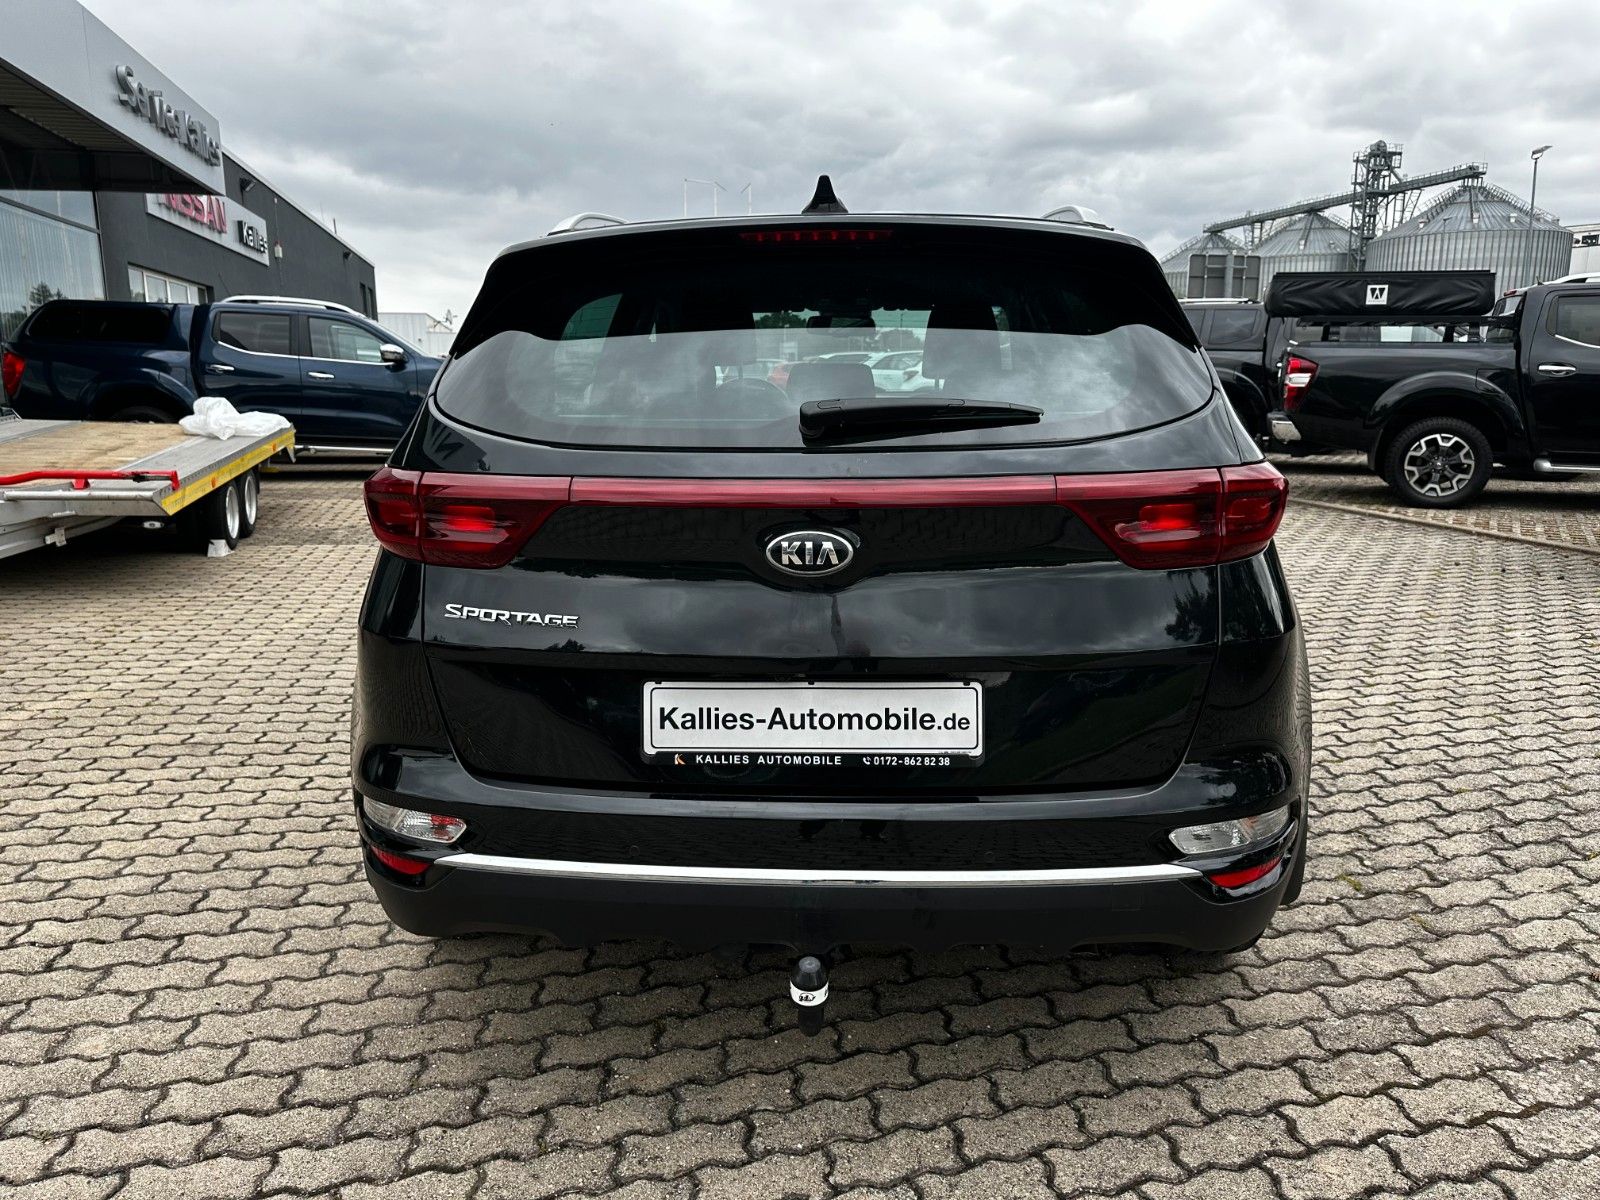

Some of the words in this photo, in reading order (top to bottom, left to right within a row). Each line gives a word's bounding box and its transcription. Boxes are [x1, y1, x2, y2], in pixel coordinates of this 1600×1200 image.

[780, 541, 839, 565] KIA
[444, 603, 579, 629] SPORTAGE
[659, 707, 971, 731] Kallies-Automobile.de
[695, 754, 750, 765] KALLIES
[757, 755, 842, 766] AUTOMOBILE
